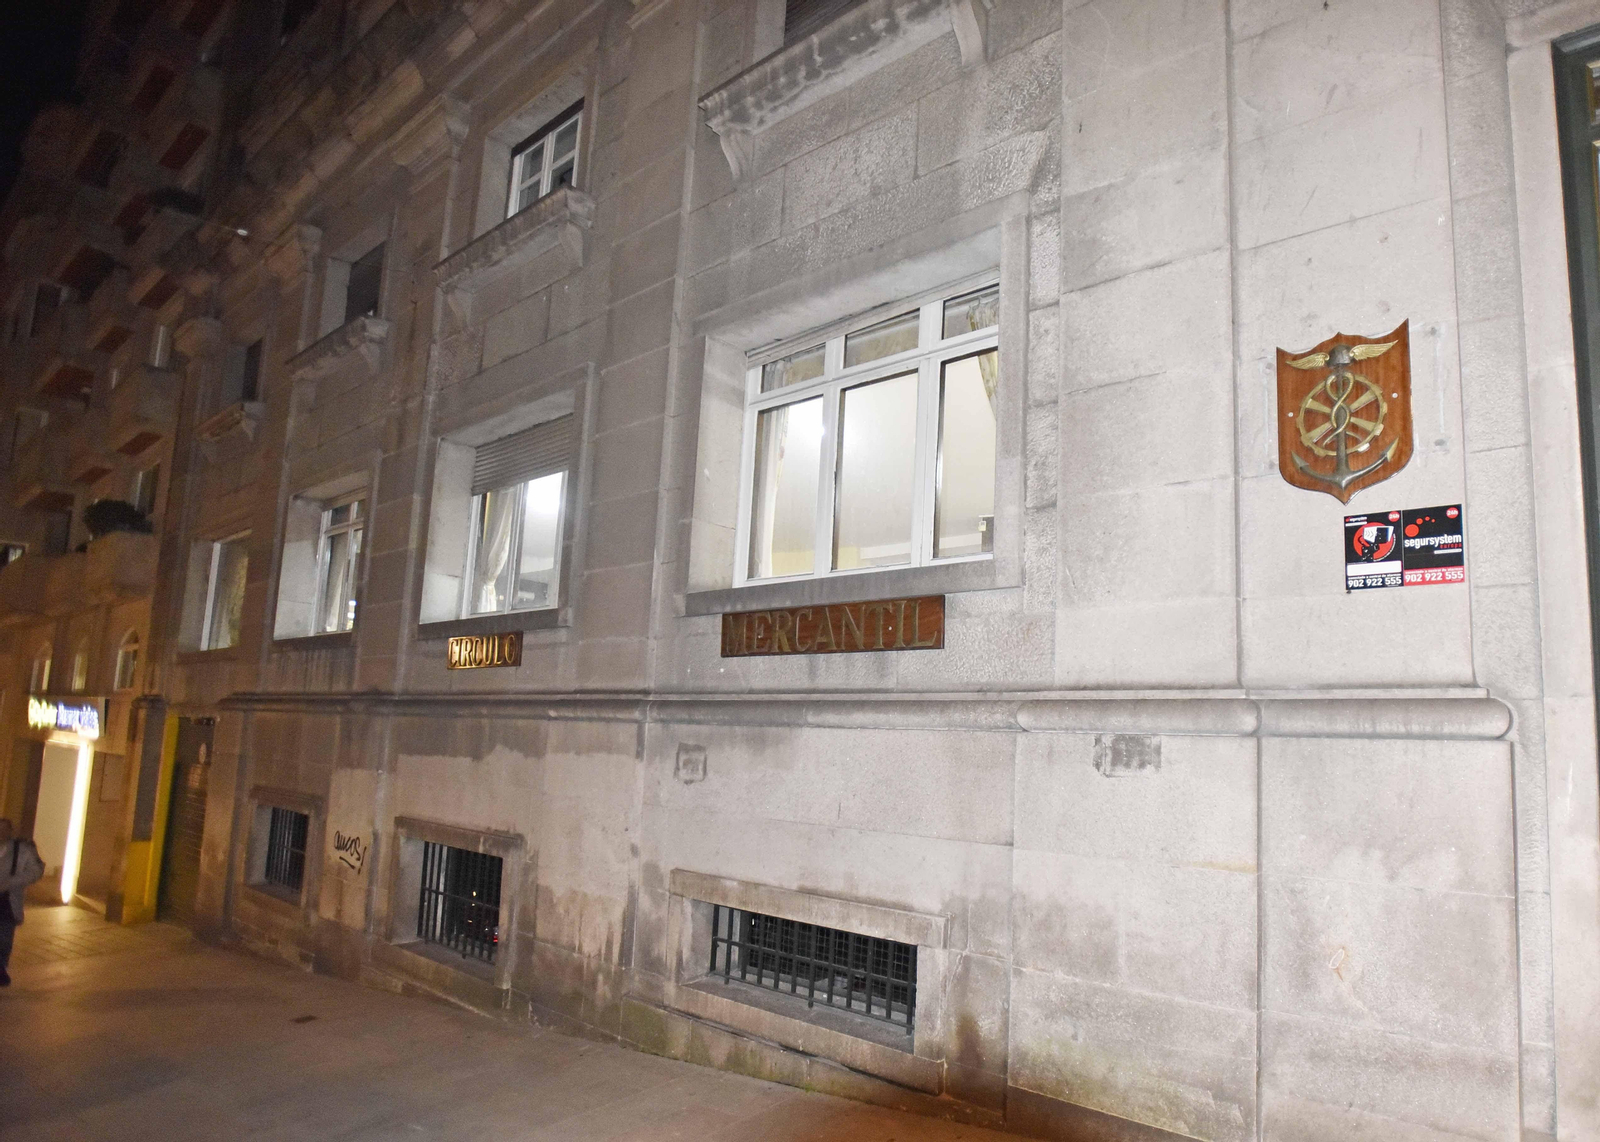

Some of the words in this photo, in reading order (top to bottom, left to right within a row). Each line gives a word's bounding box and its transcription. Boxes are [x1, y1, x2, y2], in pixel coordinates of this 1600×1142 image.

[1404, 534, 1462, 549] segursystem
[1348, 579, 1364, 588] 902
[1367, 578, 1383, 586] 922
[1385, 576, 1402, 585] 555
[1405, 573, 1422, 582] 902
[1424, 572, 1443, 581] 922
[1445, 570, 1464, 580] 555
[724, 600, 938, 655] MERCANTIL
[448, 634, 516, 667] CIRCULO
